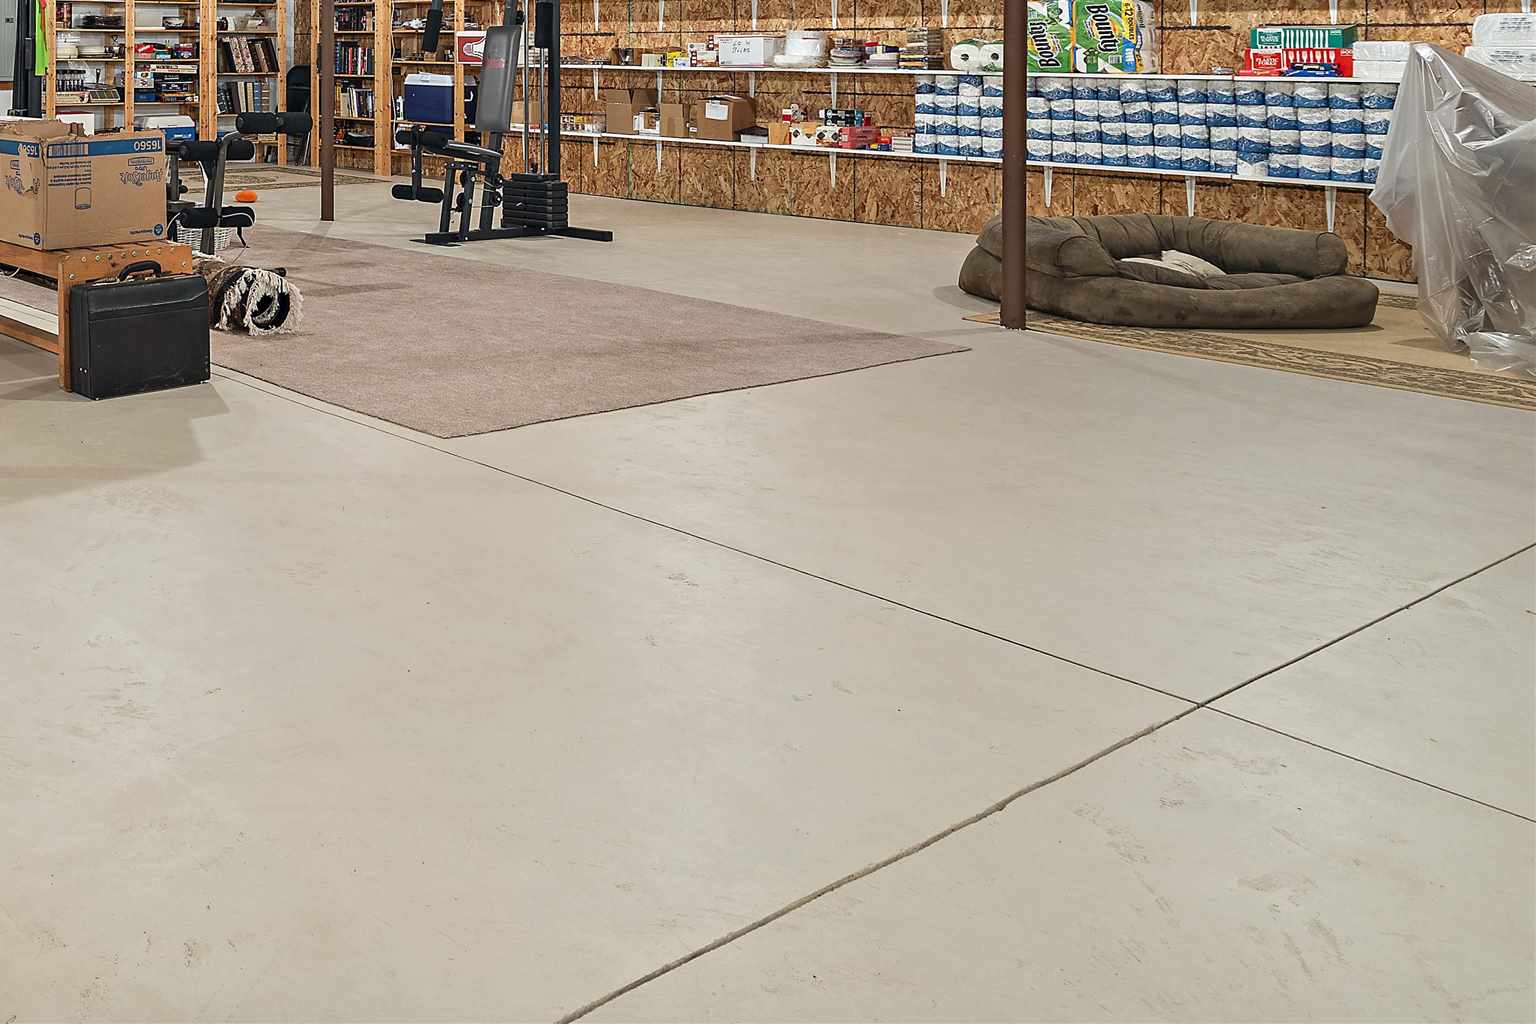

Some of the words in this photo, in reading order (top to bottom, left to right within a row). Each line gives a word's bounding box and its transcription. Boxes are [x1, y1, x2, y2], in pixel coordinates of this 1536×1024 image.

[1028, 20, 1061, 68] Bounty
[1085, 3, 1119, 53] Bounty
[133, 139, 162, 151] 16560
